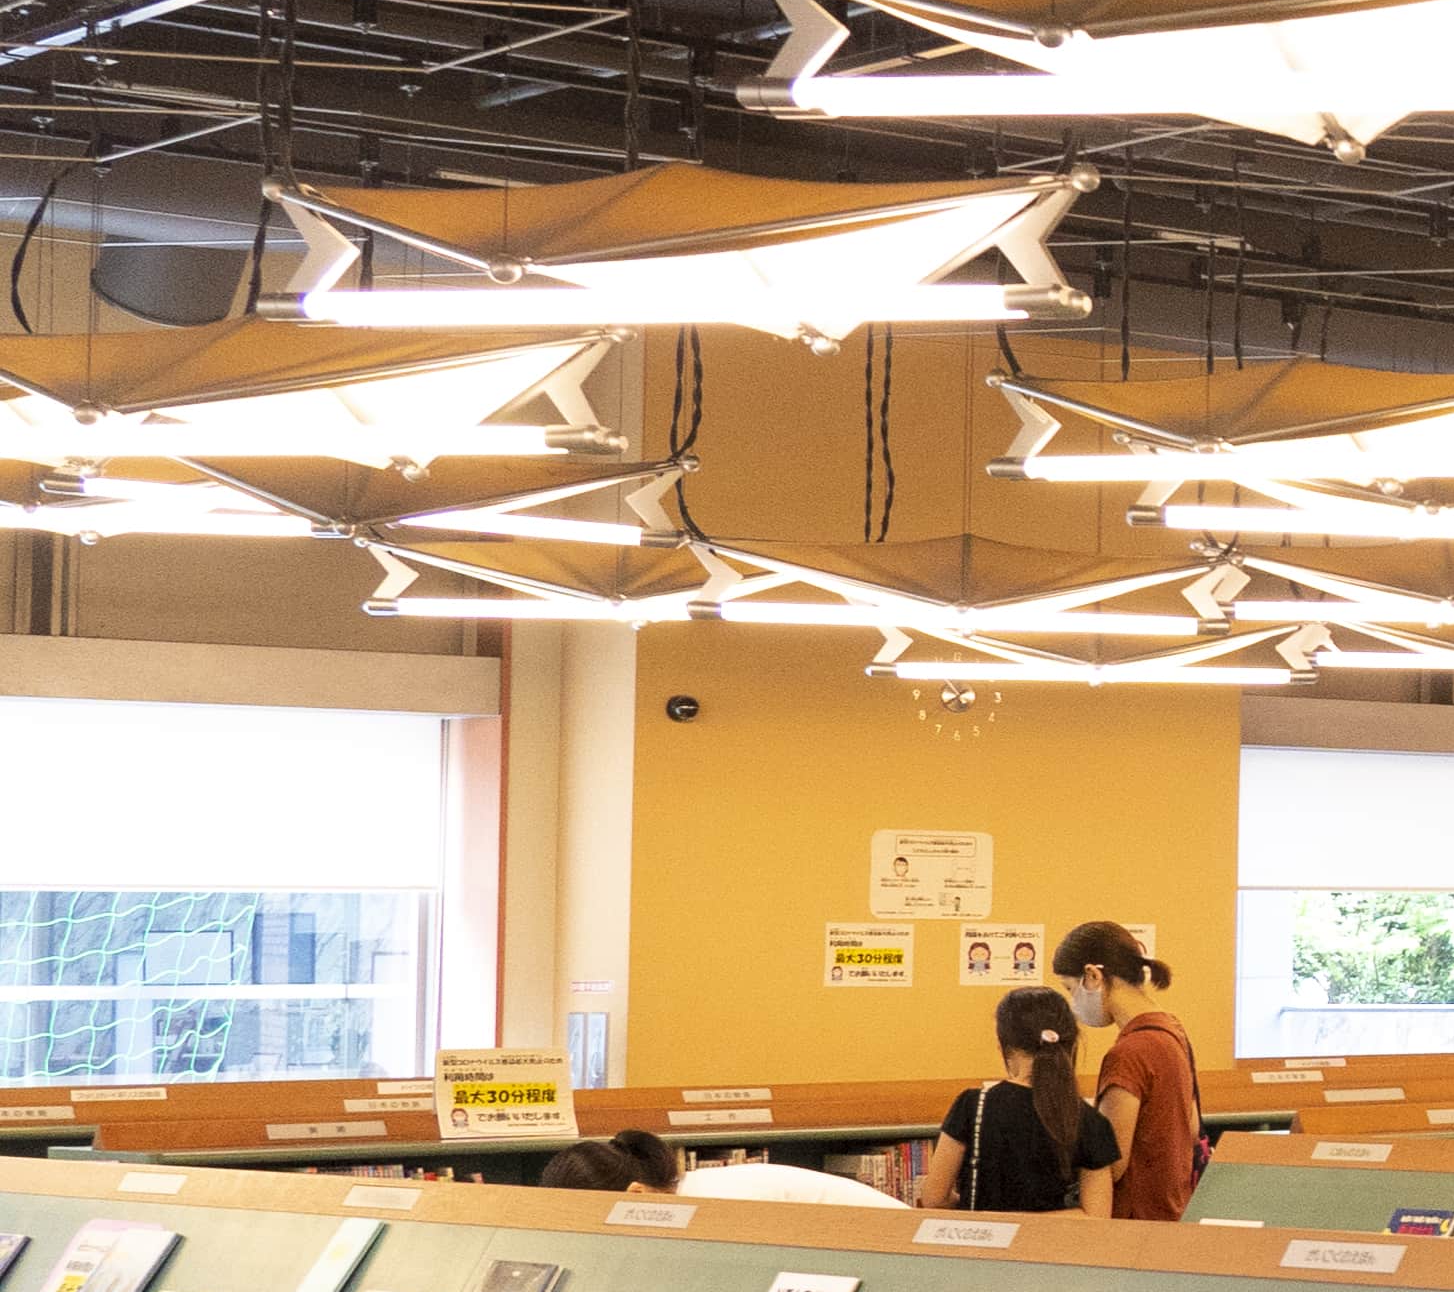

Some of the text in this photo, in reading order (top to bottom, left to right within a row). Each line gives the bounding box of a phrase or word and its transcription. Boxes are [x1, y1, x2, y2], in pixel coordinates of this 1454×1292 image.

[454, 1089, 556, 1104] 最大30分程度
